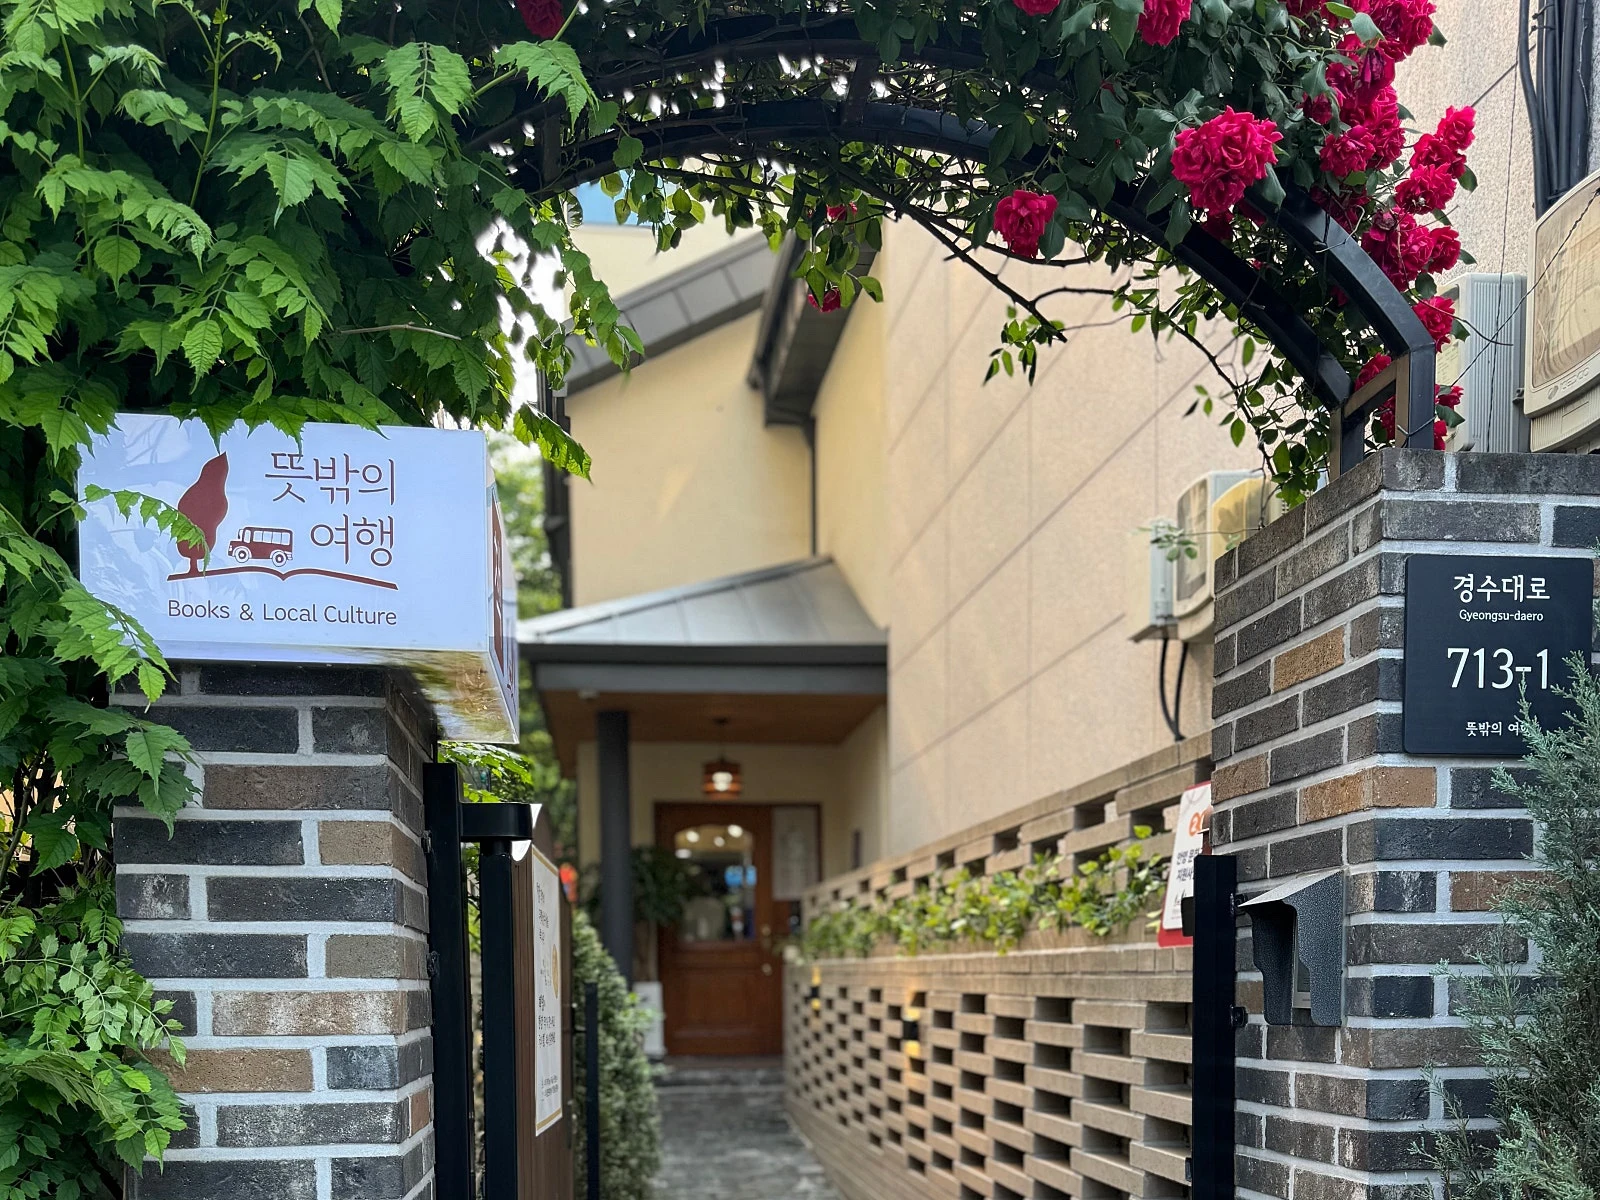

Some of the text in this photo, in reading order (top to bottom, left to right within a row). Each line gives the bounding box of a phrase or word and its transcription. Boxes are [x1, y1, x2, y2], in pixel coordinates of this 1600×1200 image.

[265, 452, 395, 506] 뜻밖의
[310, 514, 394, 567] 여행
[1453, 573, 1551, 603] 경수대로
[167, 600, 398, 626] Books & Local Culture
[1459, 609, 1544, 623] Gyeongsu-daero
[1447, 647, 1548, 690] 713-1
[1465, 721, 1503, 737] 뜻밖의
